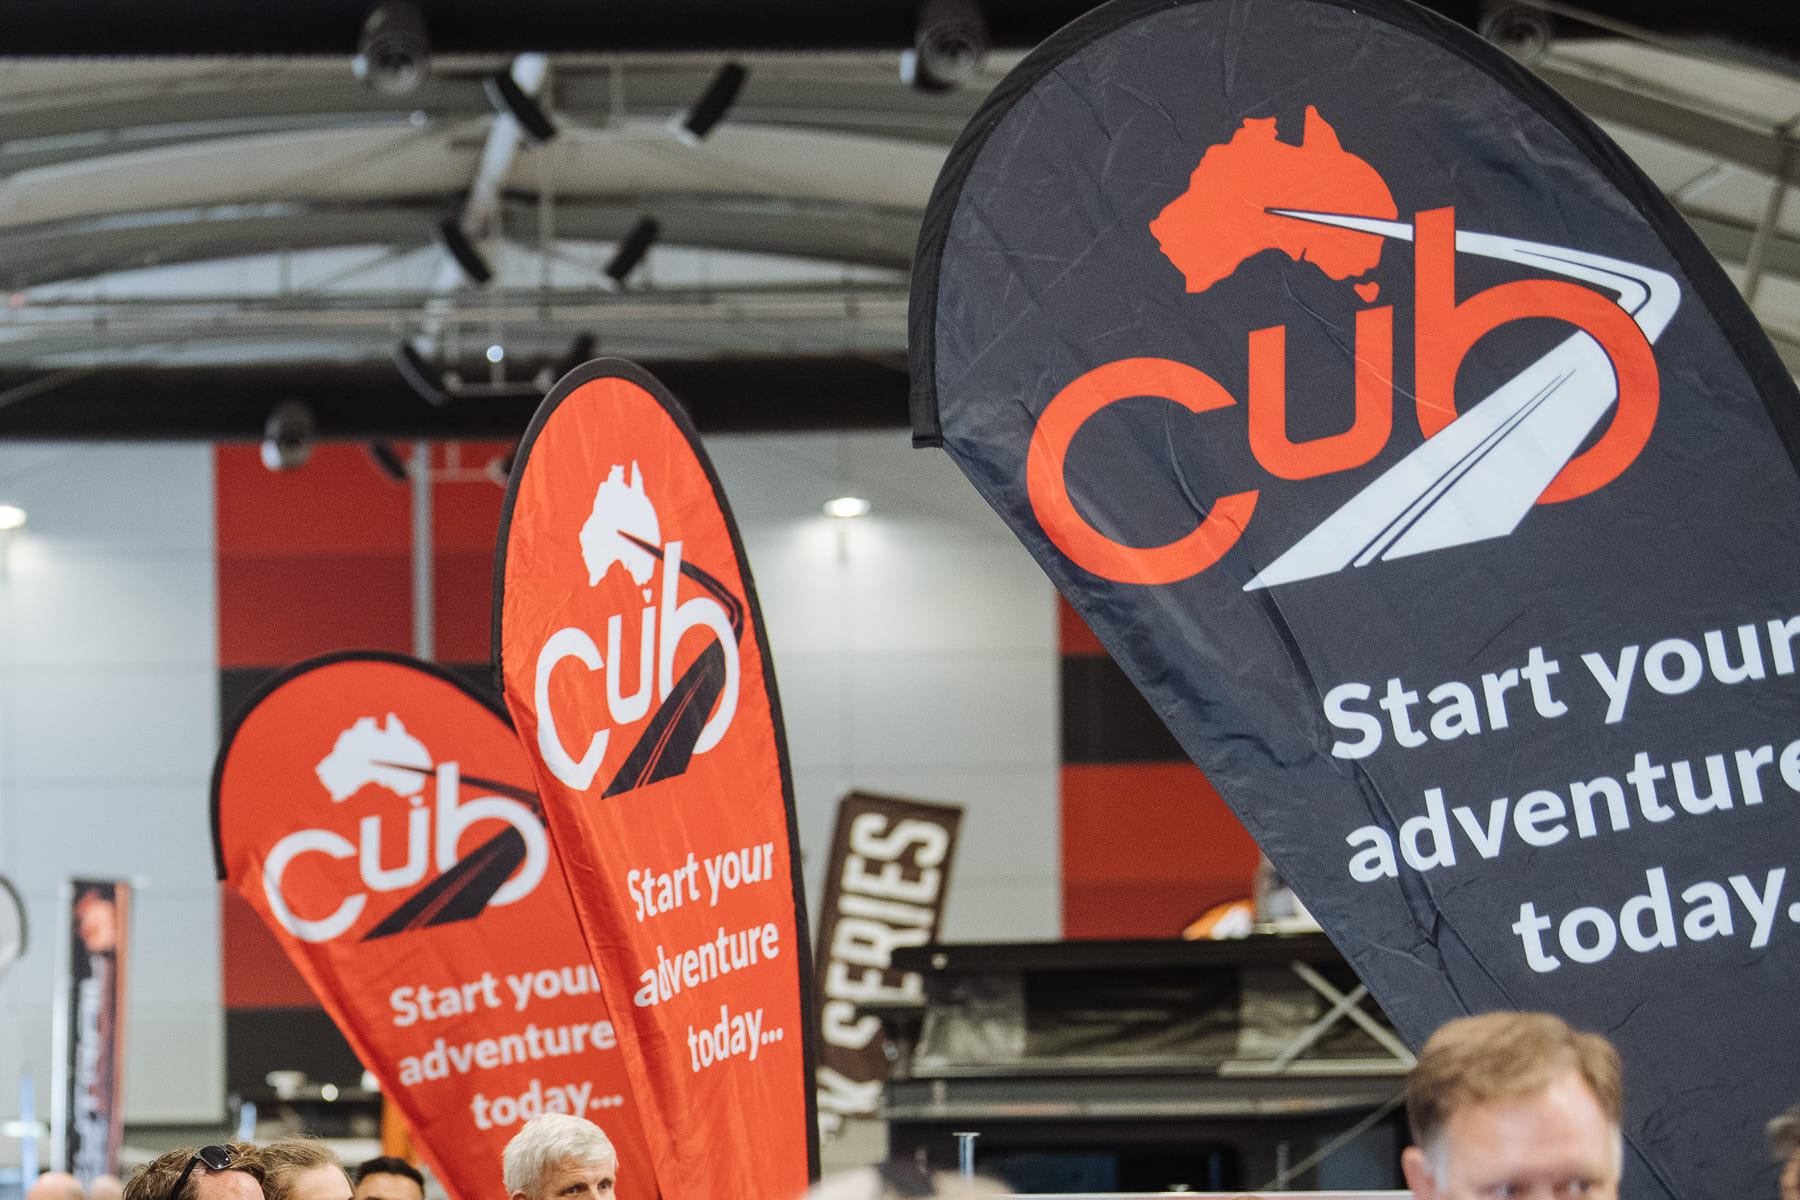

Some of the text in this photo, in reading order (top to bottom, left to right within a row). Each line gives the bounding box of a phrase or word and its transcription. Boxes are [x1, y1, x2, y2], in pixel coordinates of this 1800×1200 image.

[1325, 615, 1800, 760] Start your
[627, 842, 774, 923] Start your
[633, 922, 780, 1007] adventure
[821, 811, 949, 1049] SERIES
[389, 971, 501, 1026] Start
[399, 1019, 617, 1086] adventure
[688, 1004, 784, 1073] today...
[470, 1079, 623, 1130] today...
